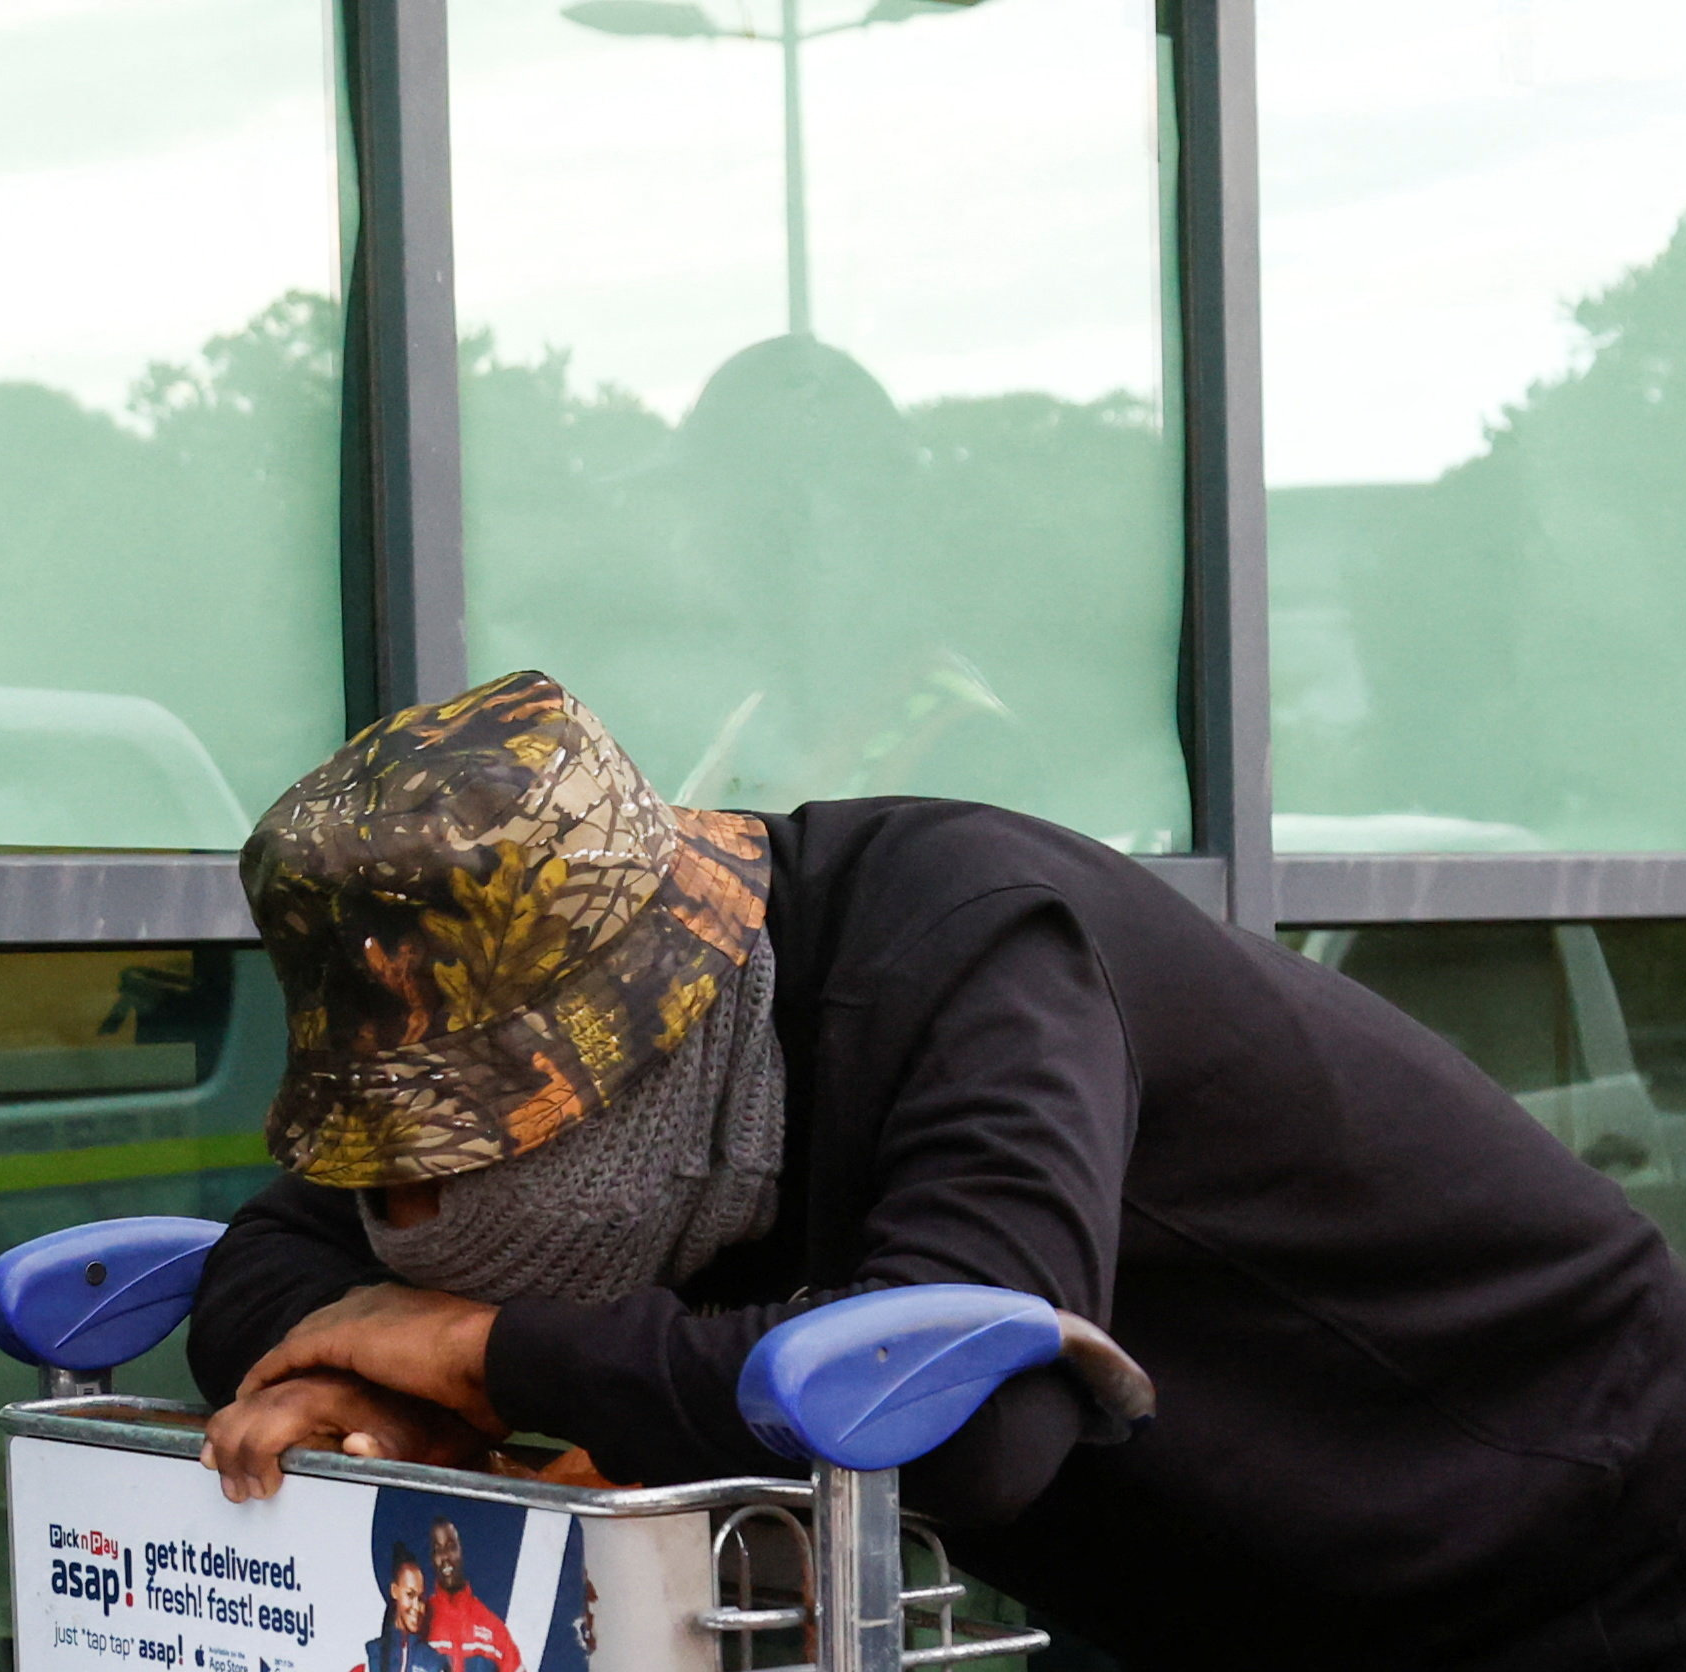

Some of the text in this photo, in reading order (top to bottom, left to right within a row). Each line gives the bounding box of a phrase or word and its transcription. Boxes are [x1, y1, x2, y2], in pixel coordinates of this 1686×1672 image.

[49, 1524, 118, 1560] Pick n Pay
[145, 1540, 302, 1592] get it delivered.
[51, 1547, 134, 1617] asap!
[146, 1578, 315, 1647] fresh! fast! easy!
[54, 1621, 78, 1648] just
[139, 1634, 183, 1670] asap!
